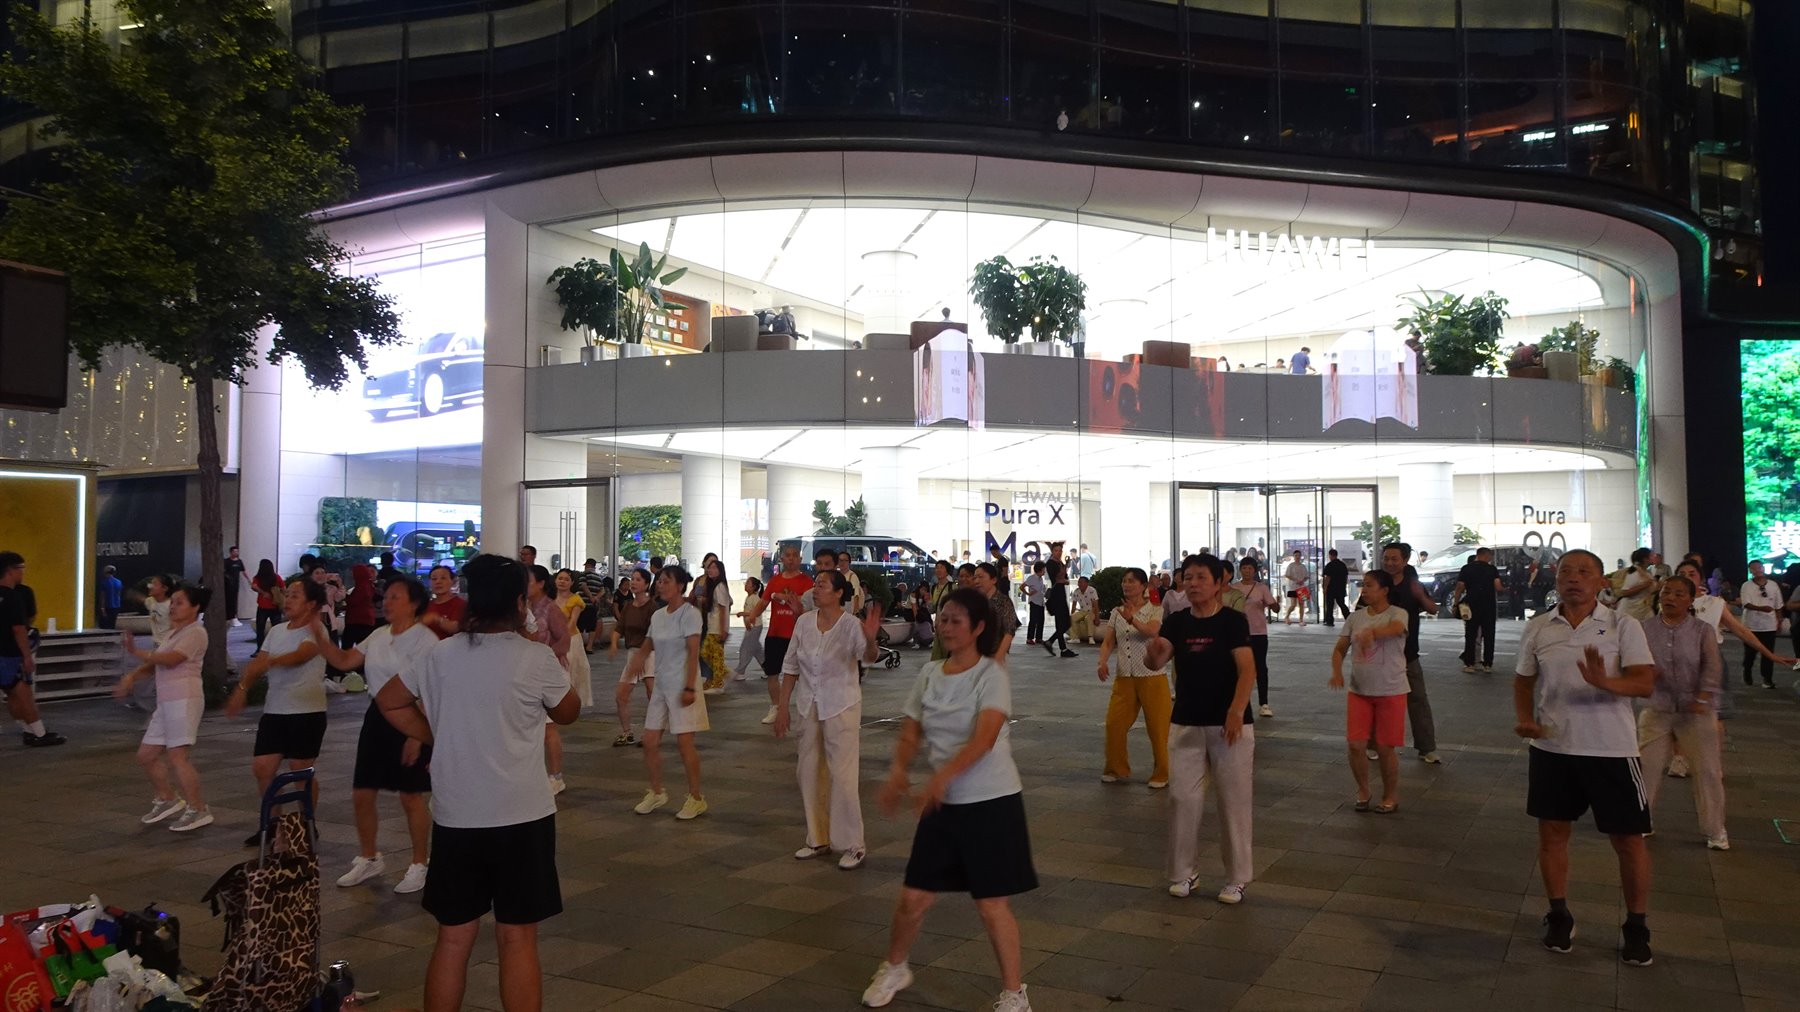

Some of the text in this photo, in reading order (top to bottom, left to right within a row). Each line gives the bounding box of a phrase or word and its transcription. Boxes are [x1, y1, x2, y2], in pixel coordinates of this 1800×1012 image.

[985, 503, 1065, 525] Pura X
[1522, 505, 1566, 525] Pura
[128, 541, 150, 556] SOON
